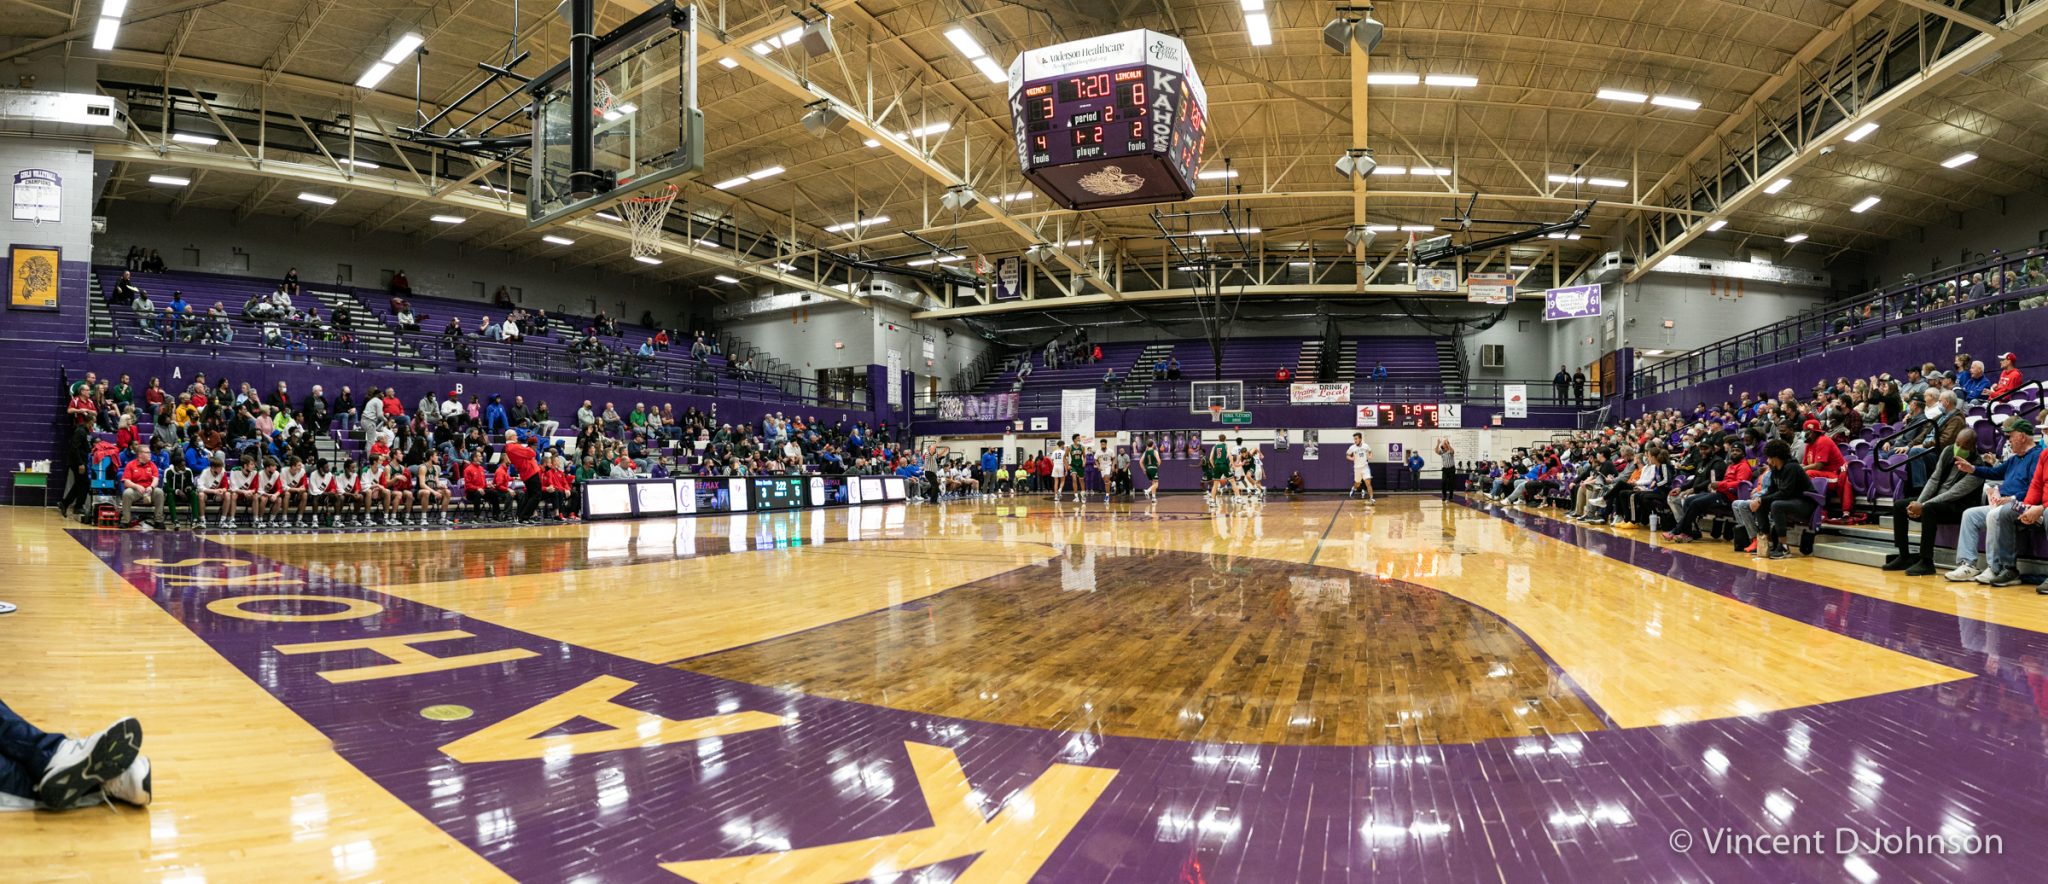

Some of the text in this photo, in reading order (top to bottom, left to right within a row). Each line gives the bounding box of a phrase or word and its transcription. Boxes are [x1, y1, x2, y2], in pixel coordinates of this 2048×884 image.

[1081, 42, 1125, 57] Healthcare
[1116, 70, 1142, 81] LINCOLN
[1071, 74, 1110, 98] 7:20
[1133, 83, 1145, 105] 8
[1043, 97, 1054, 119] 3
[1105, 106, 1114, 121] 2
[1152, 70, 1177, 152] KAHOKS
[1074, 111, 1098, 126] period
[1133, 122, 1142, 137] 2
[1037, 135, 1046, 149] 4
[1128, 142, 1146, 152] fouls
[1076, 146, 1100, 159] player
[1033, 154, 1049, 164] fouls
[1547, 300, 1556, 309] 19
[1590, 295, 1599, 305] 61
[1956, 337, 1963, 353] F
[173, 366, 181, 378] A
[456, 383, 463, 394] B
[1318, 385, 1349, 398] Local
[712, 403, 716, 411] C
[1402, 404, 1422, 416] 7:19
[1387, 411, 1394, 422] 3
[1431, 411, 1438, 422] 8
[1417, 419, 1423, 427] 2
[1054, 452, 1062, 460] 12
[1216, 448, 1222, 459] 5
[695, 481, 720, 489] RE/MAX
[794, 485, 800, 497] 5
[761, 487, 767, 498] 3
[134, 557, 1120, 884] KAHOKS
